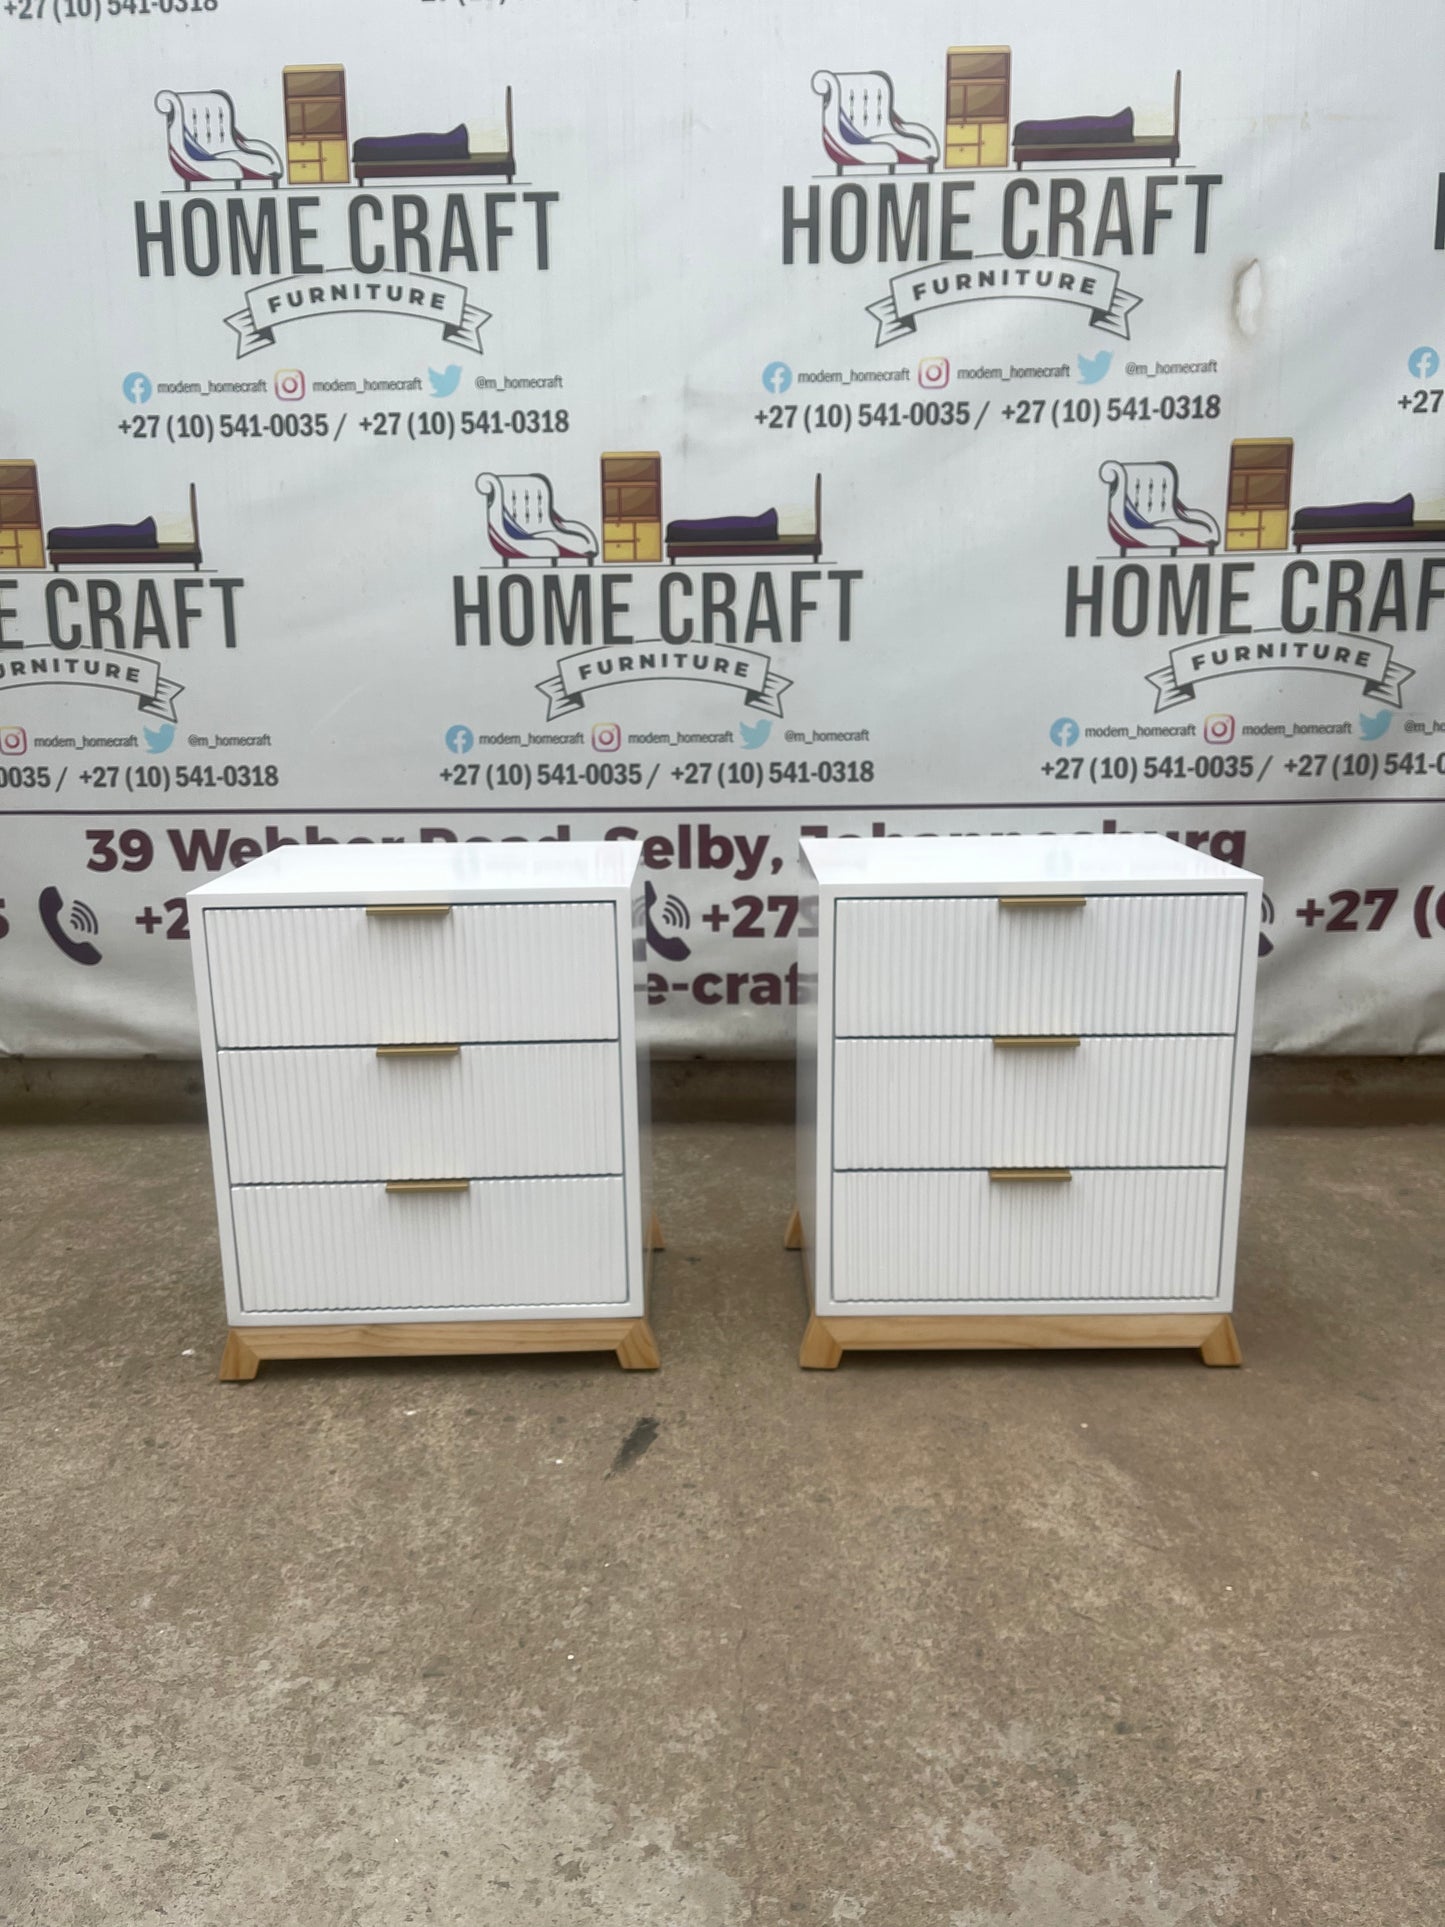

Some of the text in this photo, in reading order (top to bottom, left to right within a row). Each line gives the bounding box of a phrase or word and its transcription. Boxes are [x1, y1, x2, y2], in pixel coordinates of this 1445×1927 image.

[4, 0, 45, 19] +27
[53, 0, 101, 23] (10)
[134, 192, 559, 277] HOME CRAFT
[783, 174, 1223, 265] HOME CRAFT
[267, 283, 446, 314] FURNITURE
[912, 269, 1097, 302] FURNITURE
[755, 394, 1221, 433] +27 (10) 541-0035 / +27 (10) 541-0318
[1398, 389, 1445, 413] +27
[118, 409, 569, 443] +27 (10) 541-0035 / +27 (10) 541-0318
[45, 578, 244, 651] CRAFT
[453, 570, 863, 647] HOME CRAFT
[1065, 562, 1256, 637] HOME
[577, 653, 750, 682] FURNITURE
[1190, 642, 1372, 672] FURNITURE
[55, 767, 68, 792] /
[79, 766, 119, 787] +27
[126, 766, 170, 792] (10)
[176, 765, 278, 787] 541-0318
[440, 761, 874, 790] +27 (10) 541-0035 / +27 (10) 541-0318
[1041, 758, 1084, 779] +27
[1090, 757, 1137, 784] (10)
[1144, 755, 1254, 778] 541-0035
[1256, 755, 1273, 782] /
[1284, 754, 1328, 777] +27
[1332, 753, 1378, 781] (10)
[86, 829, 153, 872] 39
[702, 895, 798, 938] +27
[1296, 888, 1399, 933] +27
